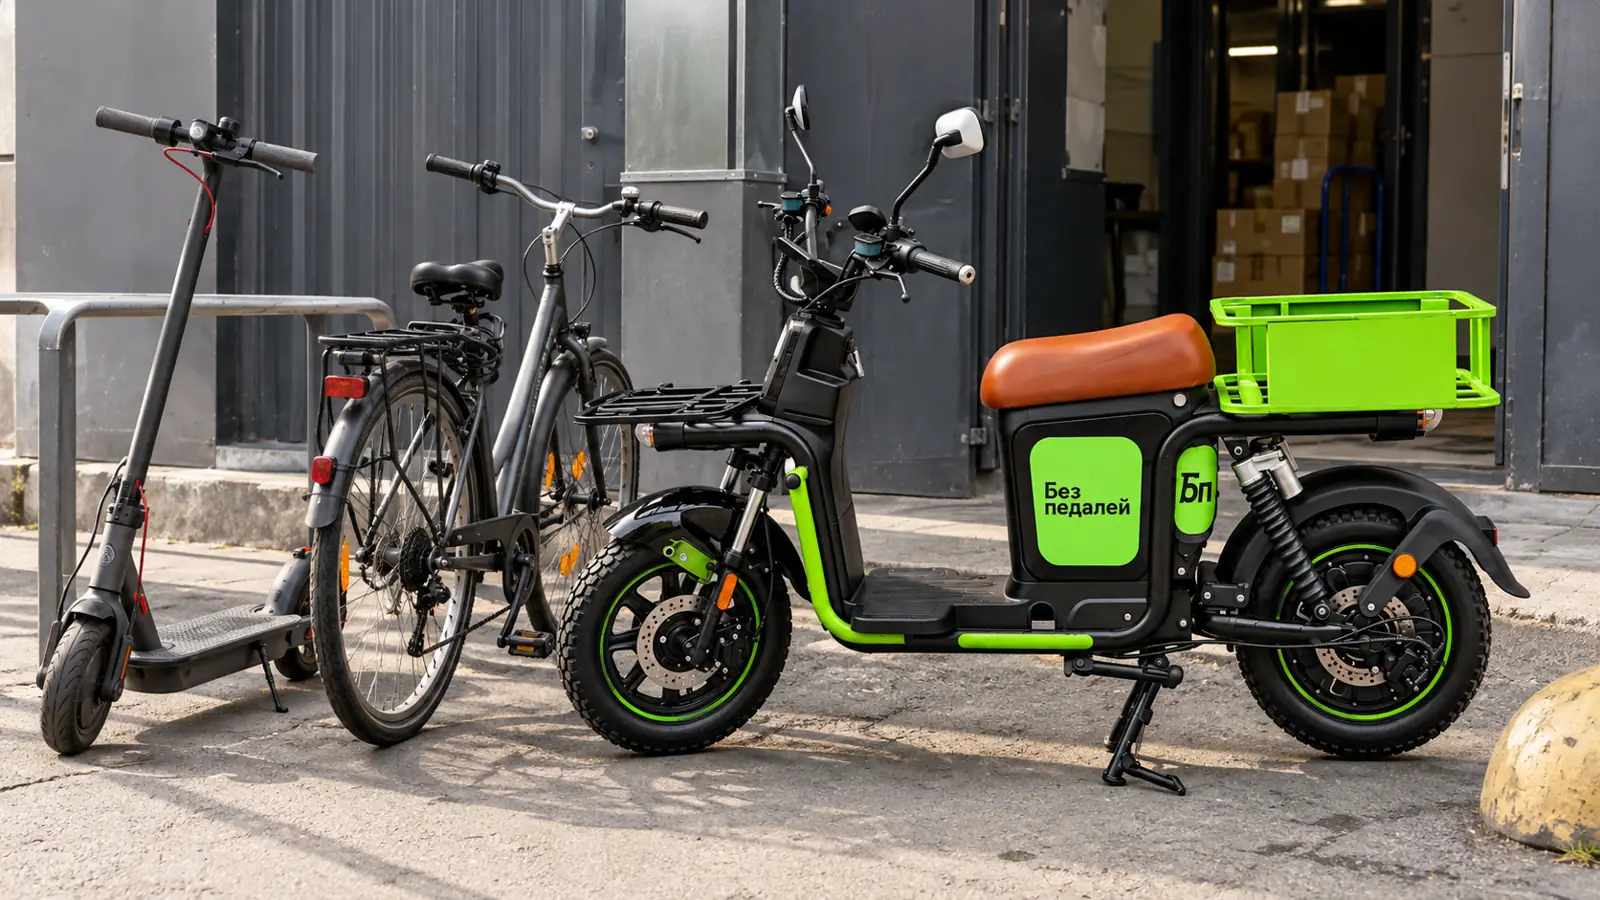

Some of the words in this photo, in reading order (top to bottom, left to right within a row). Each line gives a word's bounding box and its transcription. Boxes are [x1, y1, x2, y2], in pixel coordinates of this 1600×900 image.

[1045, 482, 1081, 499] Без
[1180, 472, 1212, 503] Бп
[1045, 498, 1130, 517] педалей
